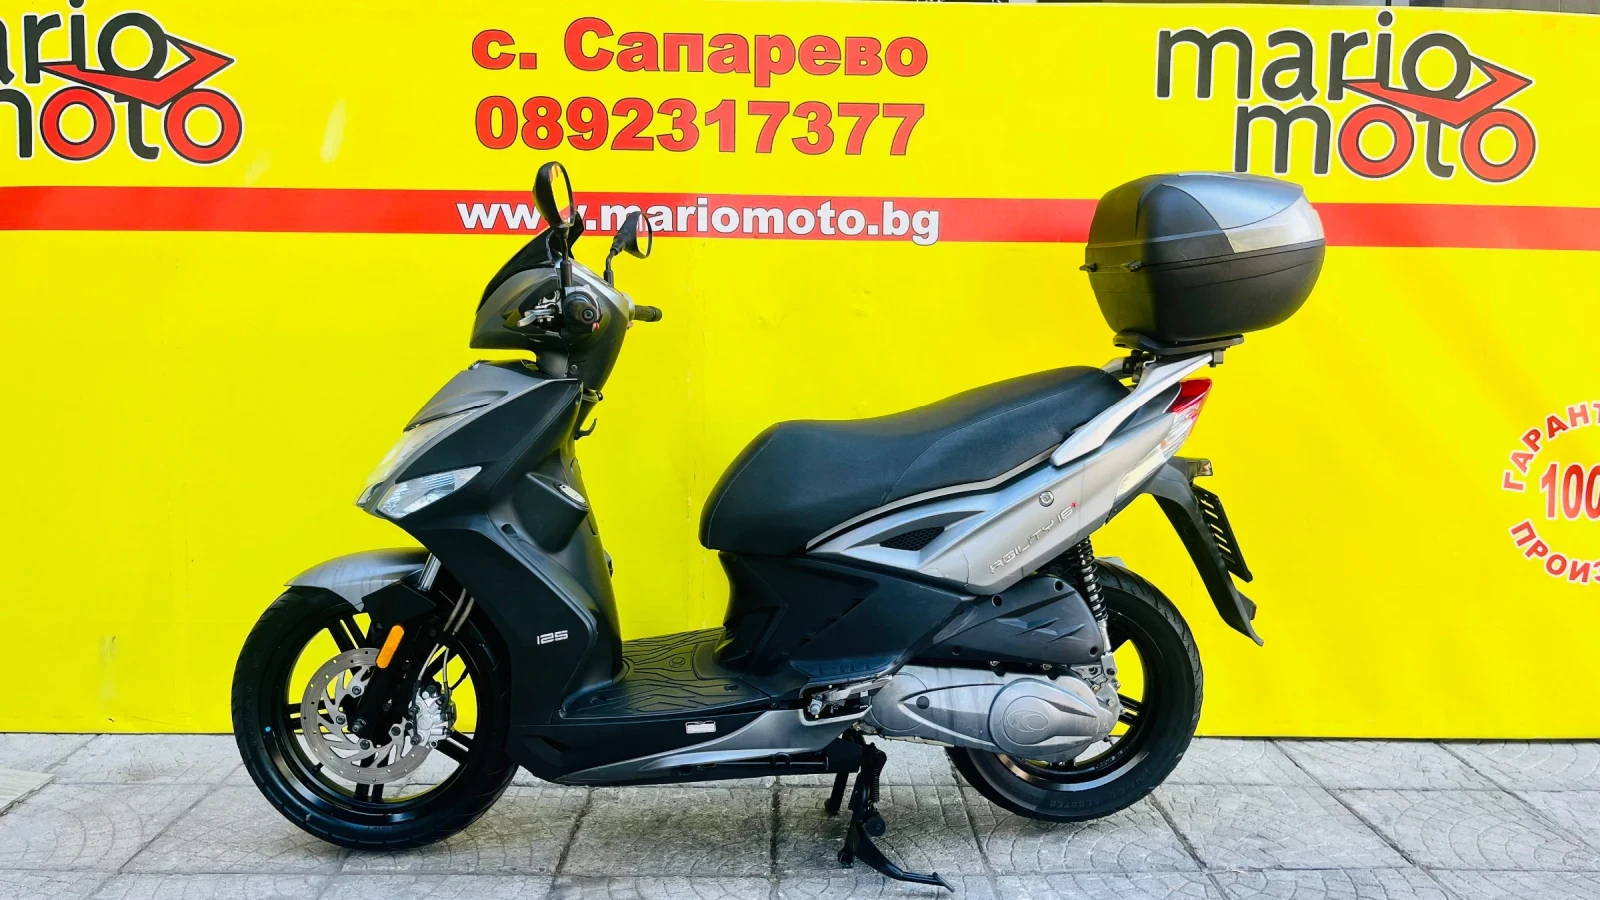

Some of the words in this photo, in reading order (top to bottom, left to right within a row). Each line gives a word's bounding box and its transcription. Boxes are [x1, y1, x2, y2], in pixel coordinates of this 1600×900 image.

[472, 29, 537, 70] с.
[564, 17, 928, 88] Сапарево
[1157, 11, 1471, 101] mario
[475, 96, 925, 156] 0892317377
[1235, 104, 1536, 182] moto
[456, 197, 940, 245] ww.mariomoto.bg
[989, 519, 1055, 574] AGILITY
[536, 630, 569, 645] 125
